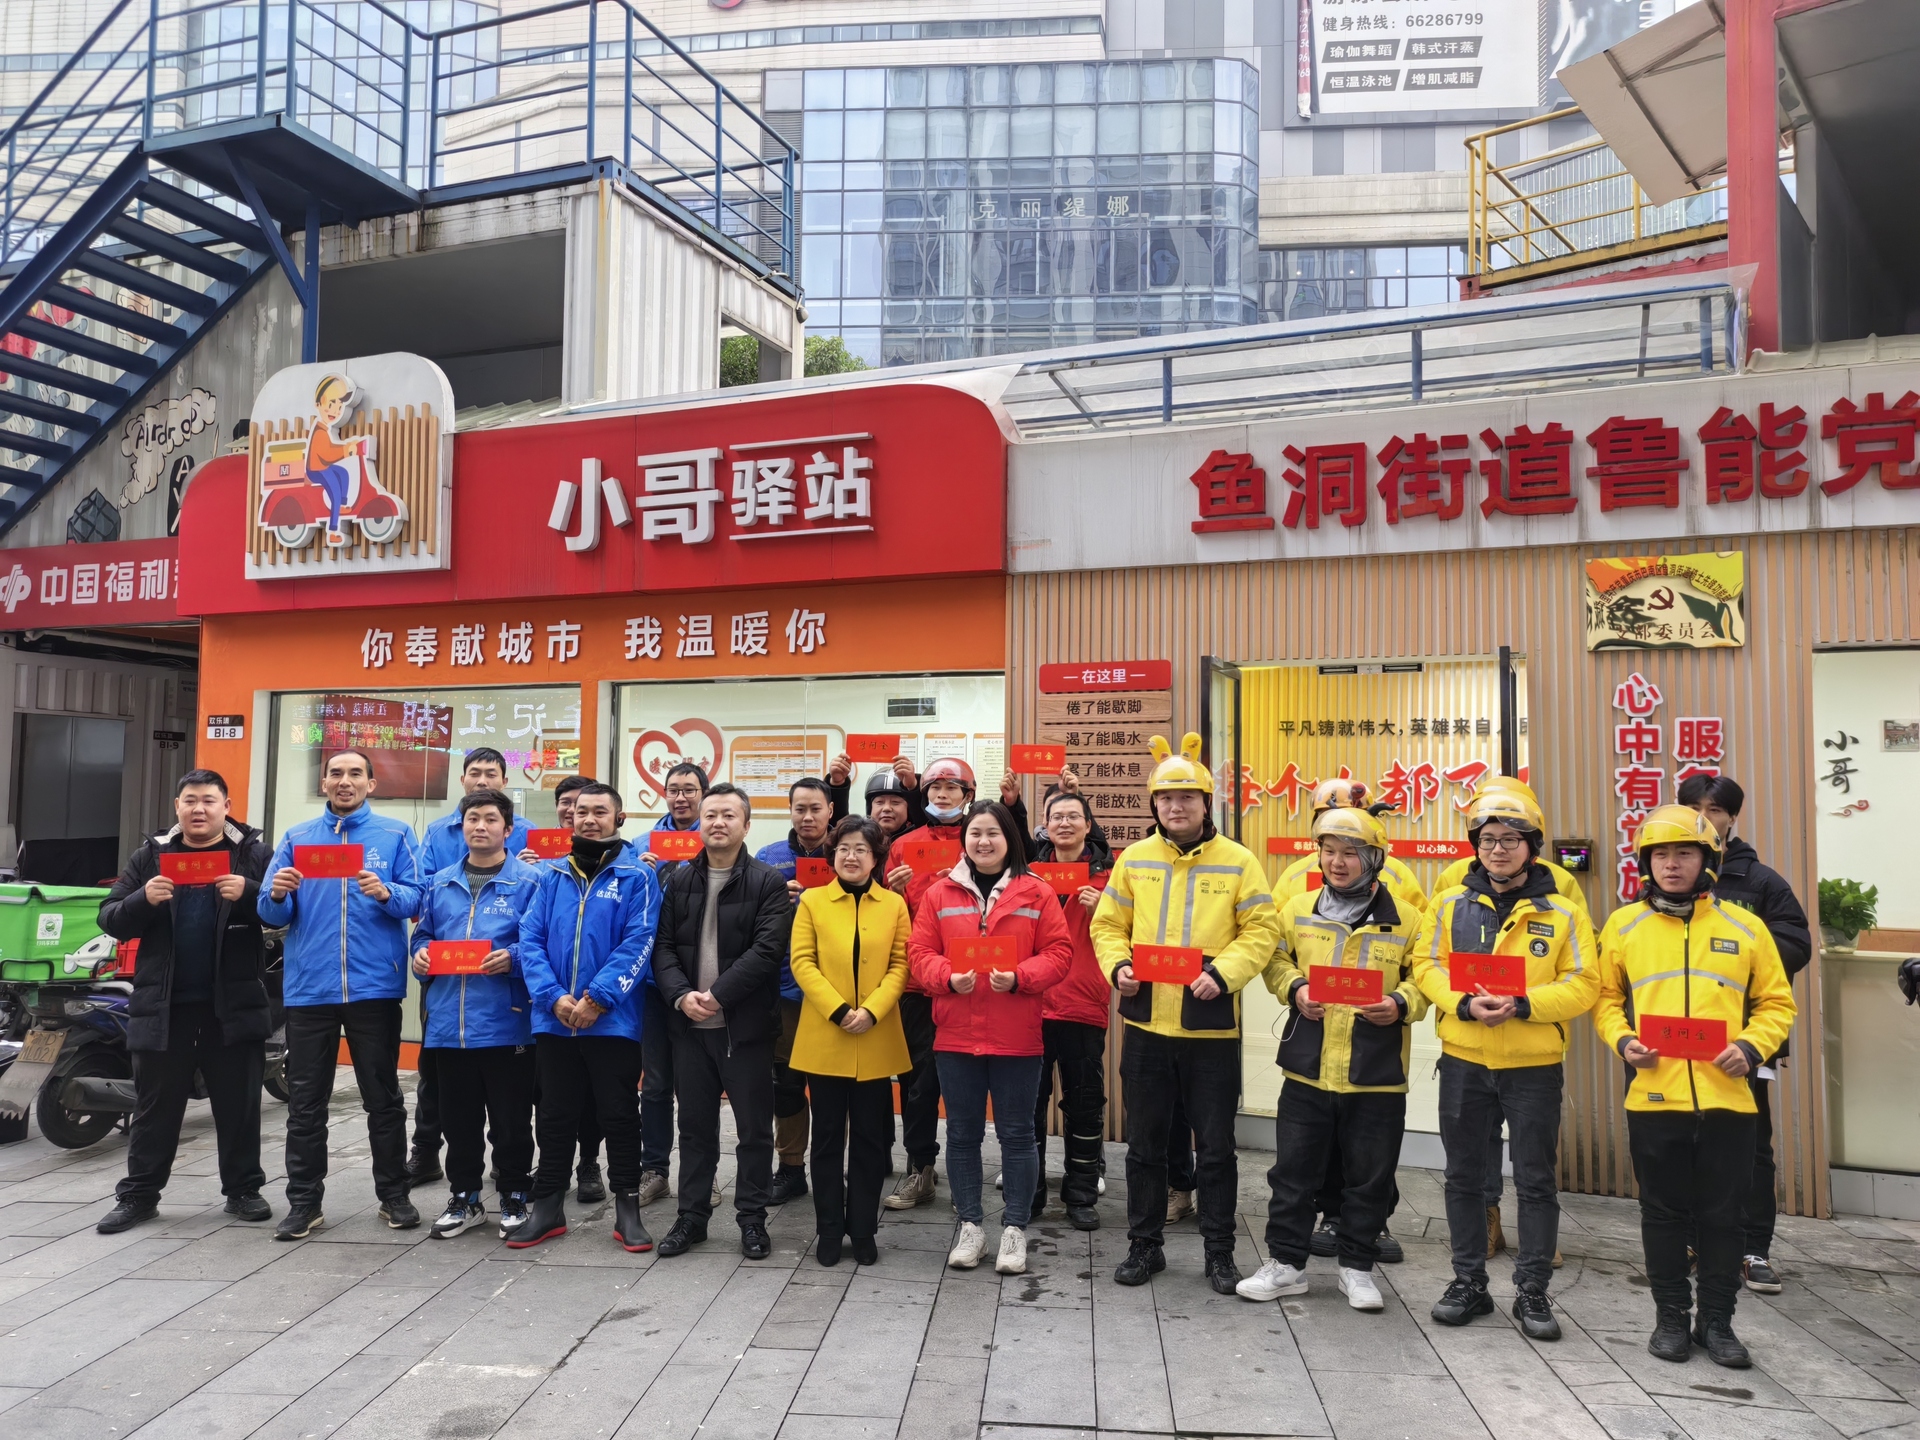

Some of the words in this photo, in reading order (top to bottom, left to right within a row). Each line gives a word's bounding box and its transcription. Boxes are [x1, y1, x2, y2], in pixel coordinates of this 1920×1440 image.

[1330, 44, 1393, 58] 瑜伽舞蹈
[1411, 41, 1474, 55] 韩式汗蒸
[1330, 75, 1393, 89] 恒温泳池
[1411, 72, 1474, 86] 增肌减脂
[973, 195, 1129, 220] 克丽缇娜
[1189, 391, 1920, 533] 鱼洞街道鲁能党
[548, 446, 874, 552] 小哥驿站
[40, 558, 179, 605] 中国福利
[361, 619, 582, 668] 你奉献城市
[624, 608, 826, 660] 我温暖你
[1081, 668, 1127, 685] 在这里
[1067, 699, 1142, 716] 倦了能歇脚
[1066, 731, 1142, 747] 渴了能喝水
[1673, 718, 1724, 785] 服
[1067, 762, 1142, 777] 累了能休息
[1820, 730, 1860, 794] 小哥
[1212, 757, 1528, 823] 每个都了
[662, 837, 697, 848] 慰问金
[1416, 843, 1458, 855] 以心换心
[1148, 954, 1189, 967] 慰问金
[1466, 963, 1509, 976] 慰问金
[1325, 975, 1368, 989] 慰问金
[1661, 1026, 1708, 1041] 慰问金
